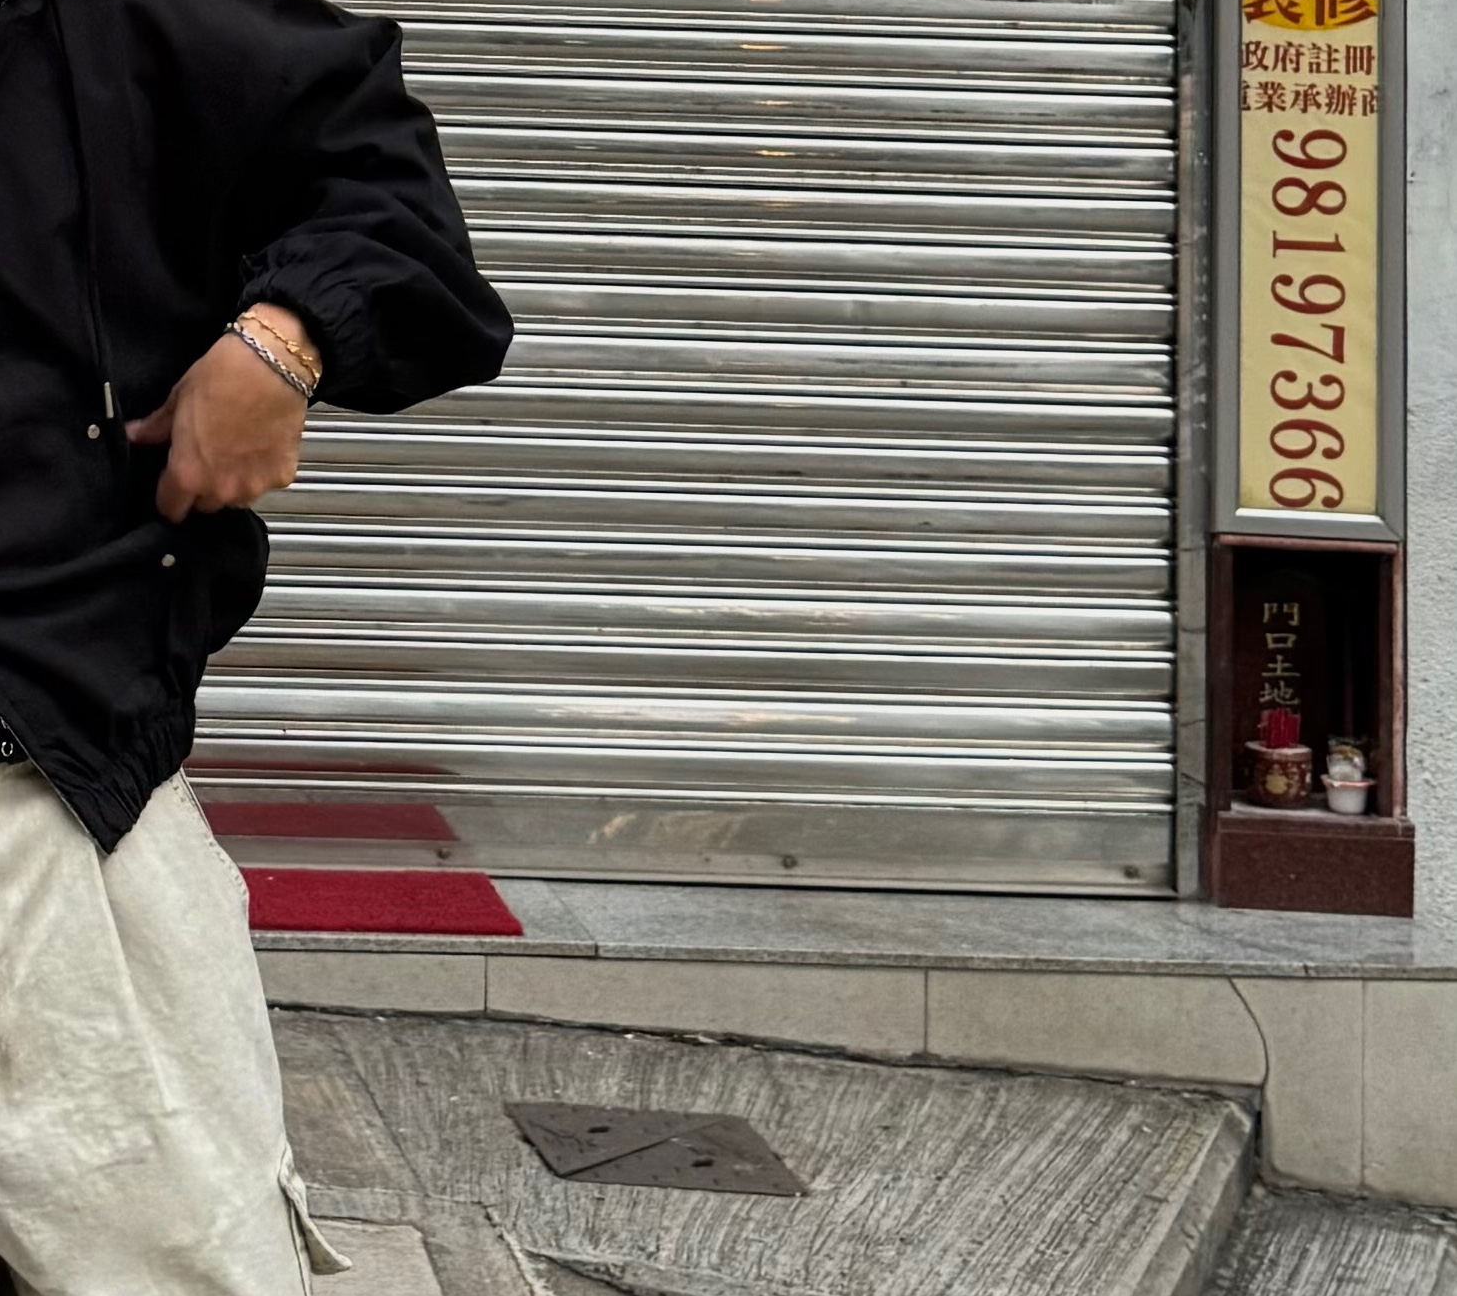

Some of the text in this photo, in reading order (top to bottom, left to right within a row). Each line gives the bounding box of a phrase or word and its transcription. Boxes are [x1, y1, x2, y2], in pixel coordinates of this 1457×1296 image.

[1242, 41, 1375, 75] 政府註冊
[1269, 129, 1347, 509] 98197366
